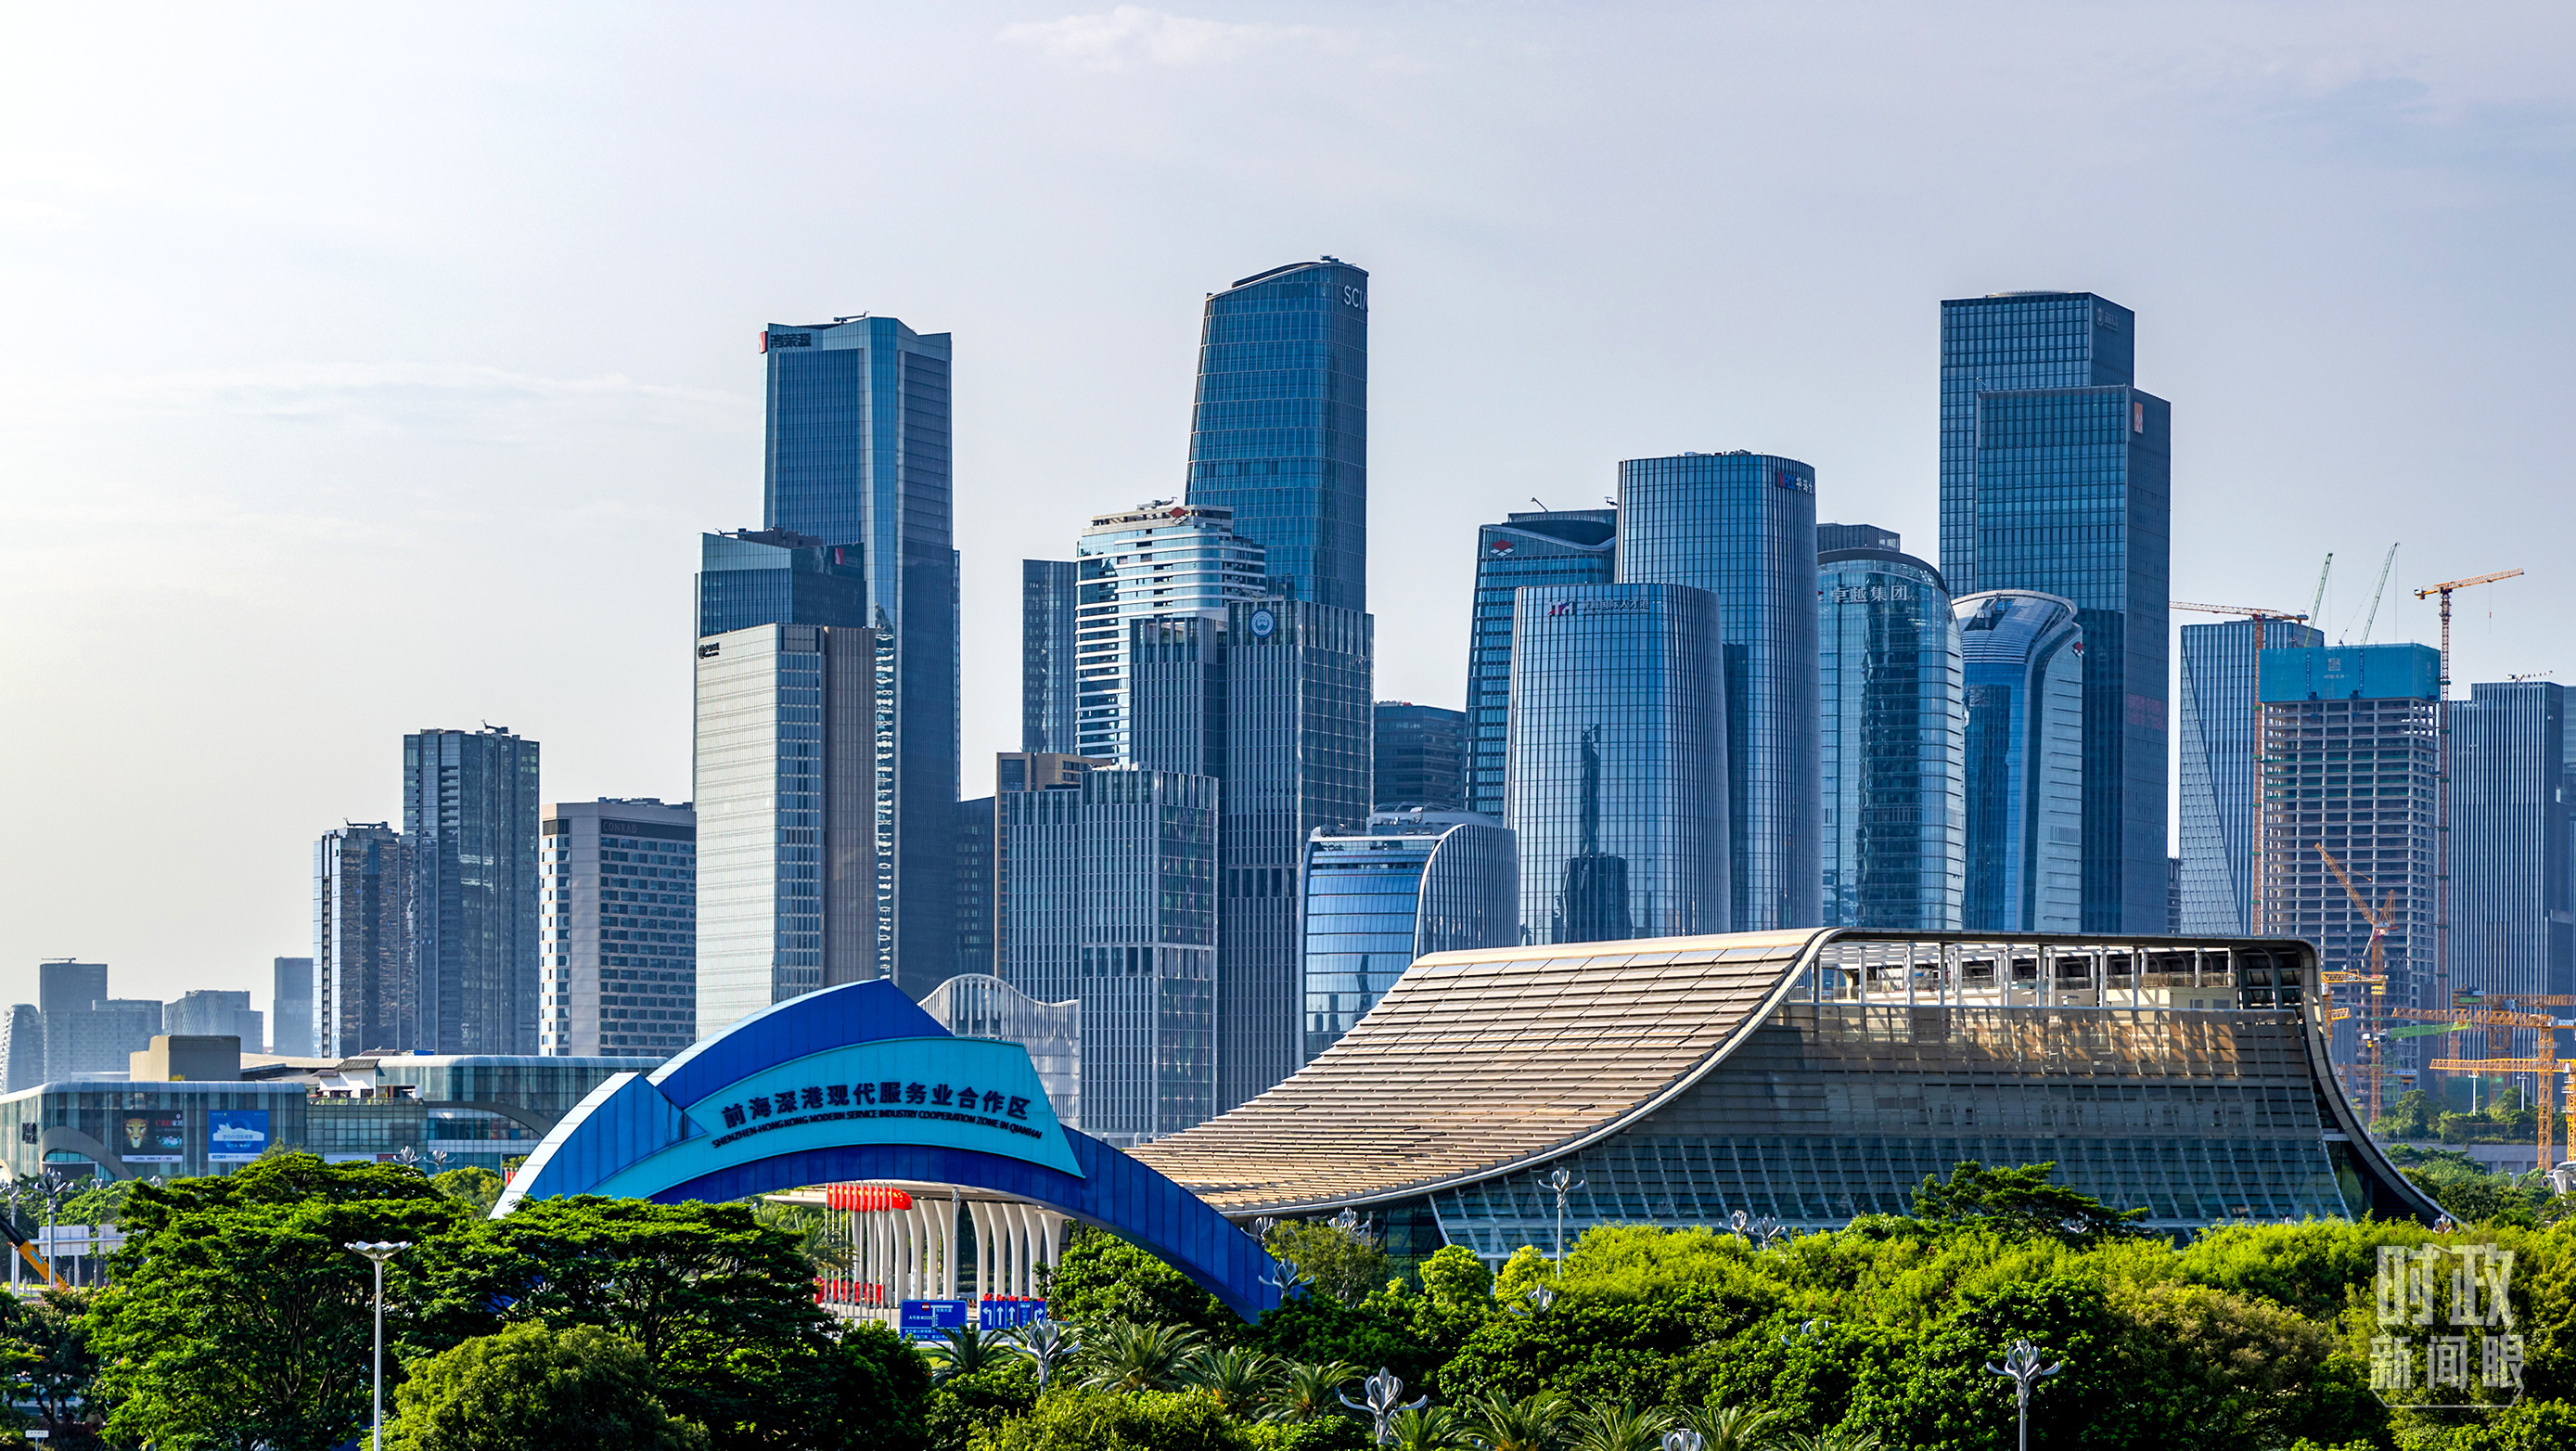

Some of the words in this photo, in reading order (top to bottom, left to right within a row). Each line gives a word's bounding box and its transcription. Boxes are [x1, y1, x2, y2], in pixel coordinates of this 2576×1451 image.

[1830, 585, 1907, 603] 卓越集团
[603, 821, 637, 834] CONRAD
[722, 1081, 1031, 1129] 前海深港现代服务业合作区
[785, 1115, 809, 1127] KONG
[810, 1111, 845, 1123] MODERN
[846, 1110, 878, 1119] SERVICE
[878, 1109, 918, 1119] INDUSTRY
[918, 1110, 976, 1124] COOPERATION
[976, 1116, 999, 1128] ZONE
[1000, 1121, 1009, 1131] IN
[1009, 1123, 1043, 1139] QIANHAI
